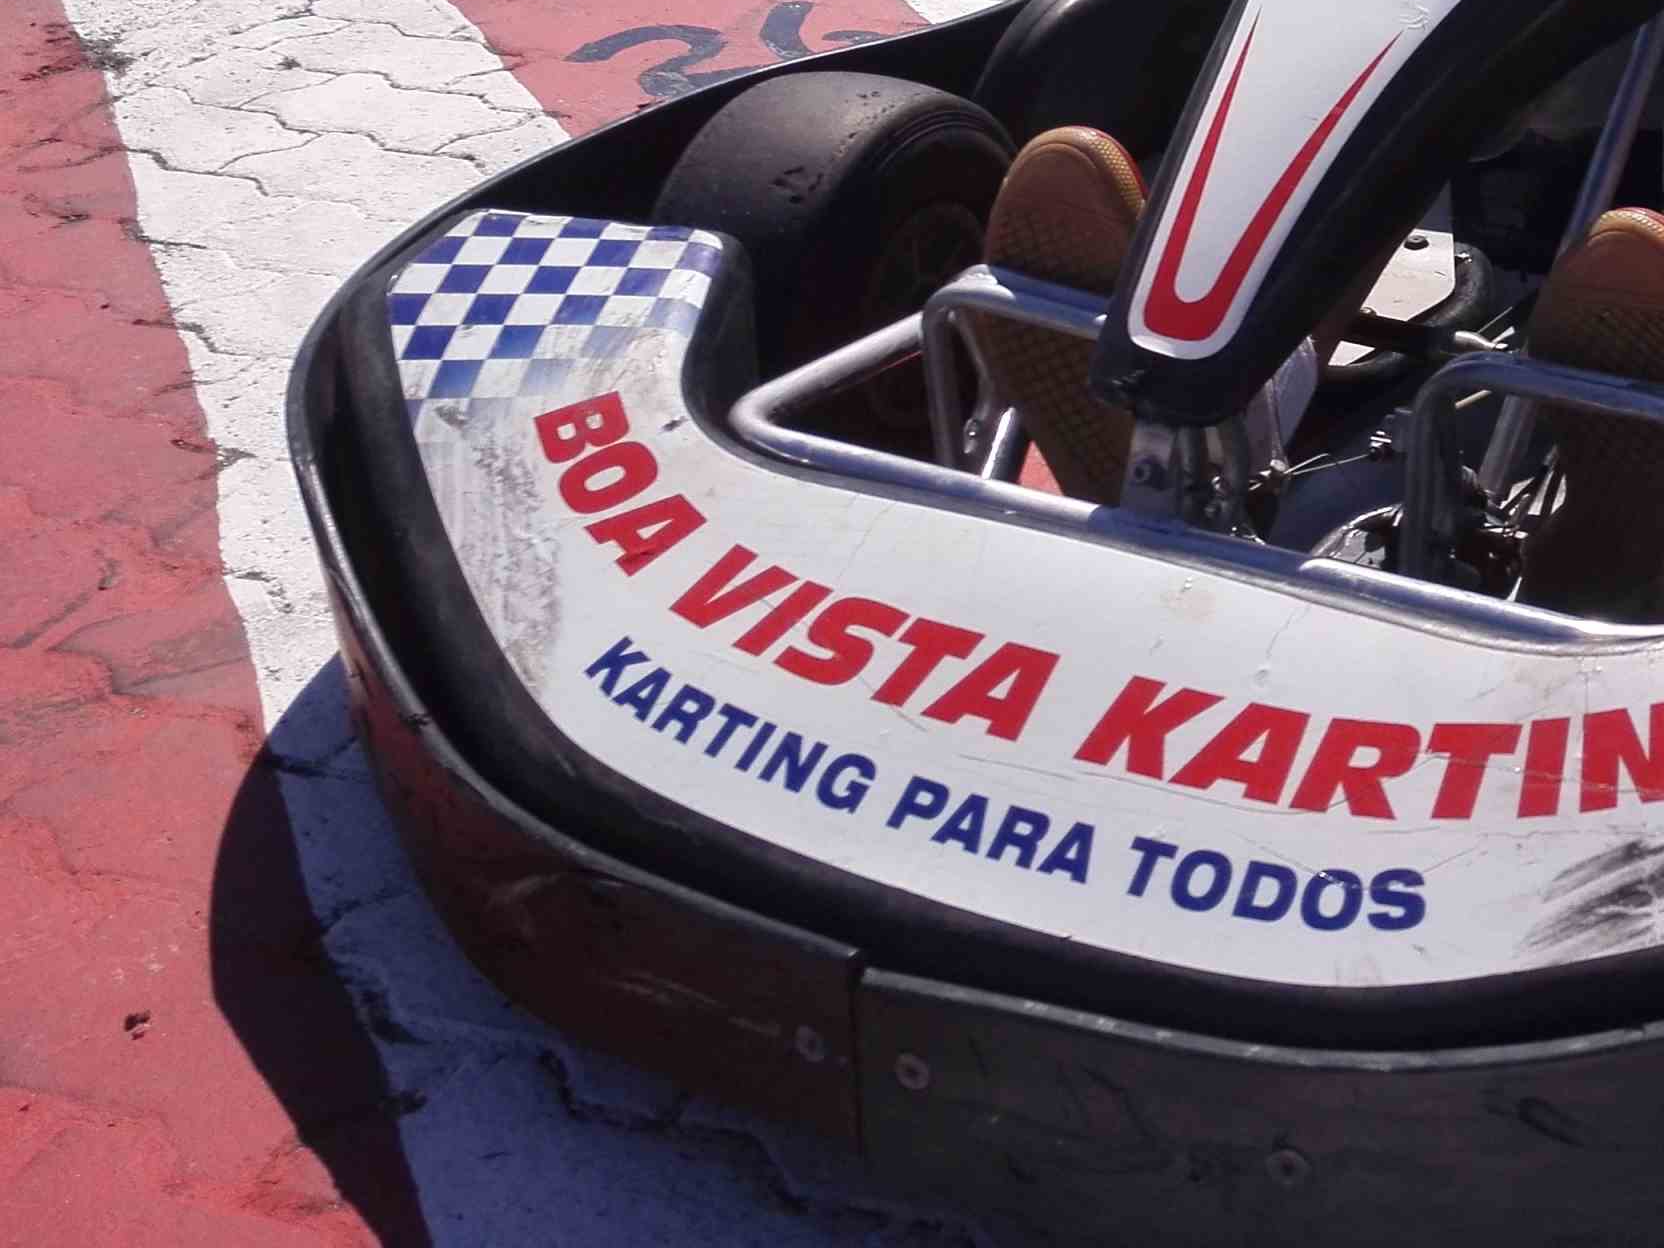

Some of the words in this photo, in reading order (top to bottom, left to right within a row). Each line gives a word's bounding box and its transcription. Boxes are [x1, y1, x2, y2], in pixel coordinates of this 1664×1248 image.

[534, 391, 707, 577] BOA
[668, 544, 1060, 742] VISTA
[584, 636, 877, 814] KARTING
[886, 775, 1096, 884] PARA
[1126, 836, 1426, 932] TODOS
